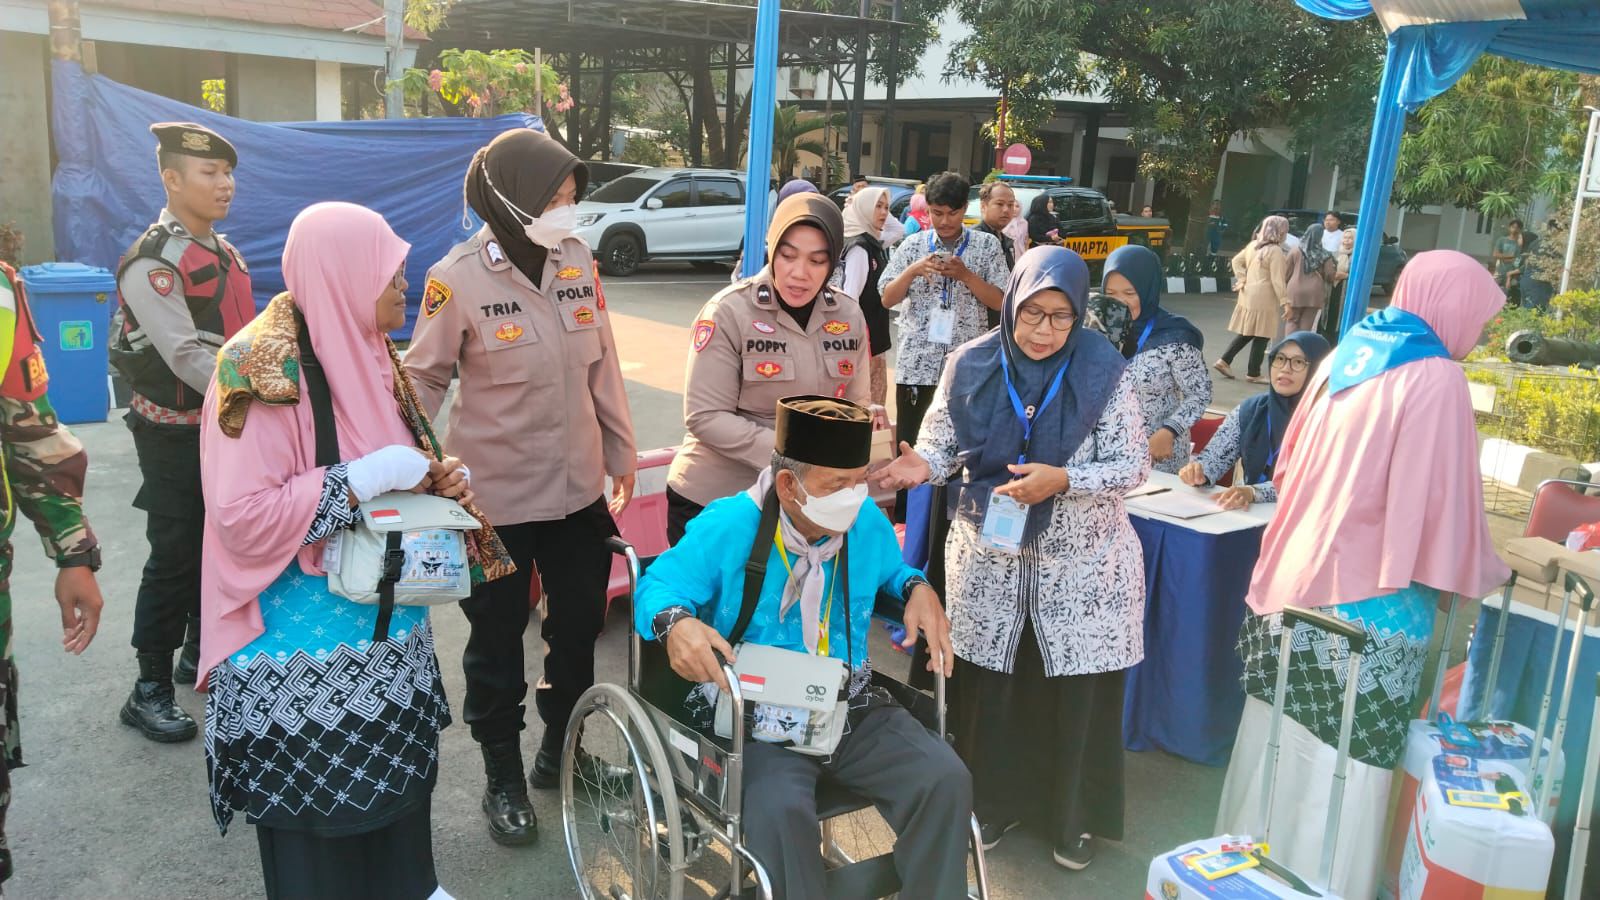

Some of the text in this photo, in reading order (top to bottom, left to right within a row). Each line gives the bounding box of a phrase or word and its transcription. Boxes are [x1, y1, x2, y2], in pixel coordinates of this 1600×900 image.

[556, 286, 594, 302] POLRI
[481, 301, 522, 318] TRIA
[746, 339, 787, 354] POPPY
[823, 338, 858, 352] POLRI
[1343, 345, 1374, 377] 3
